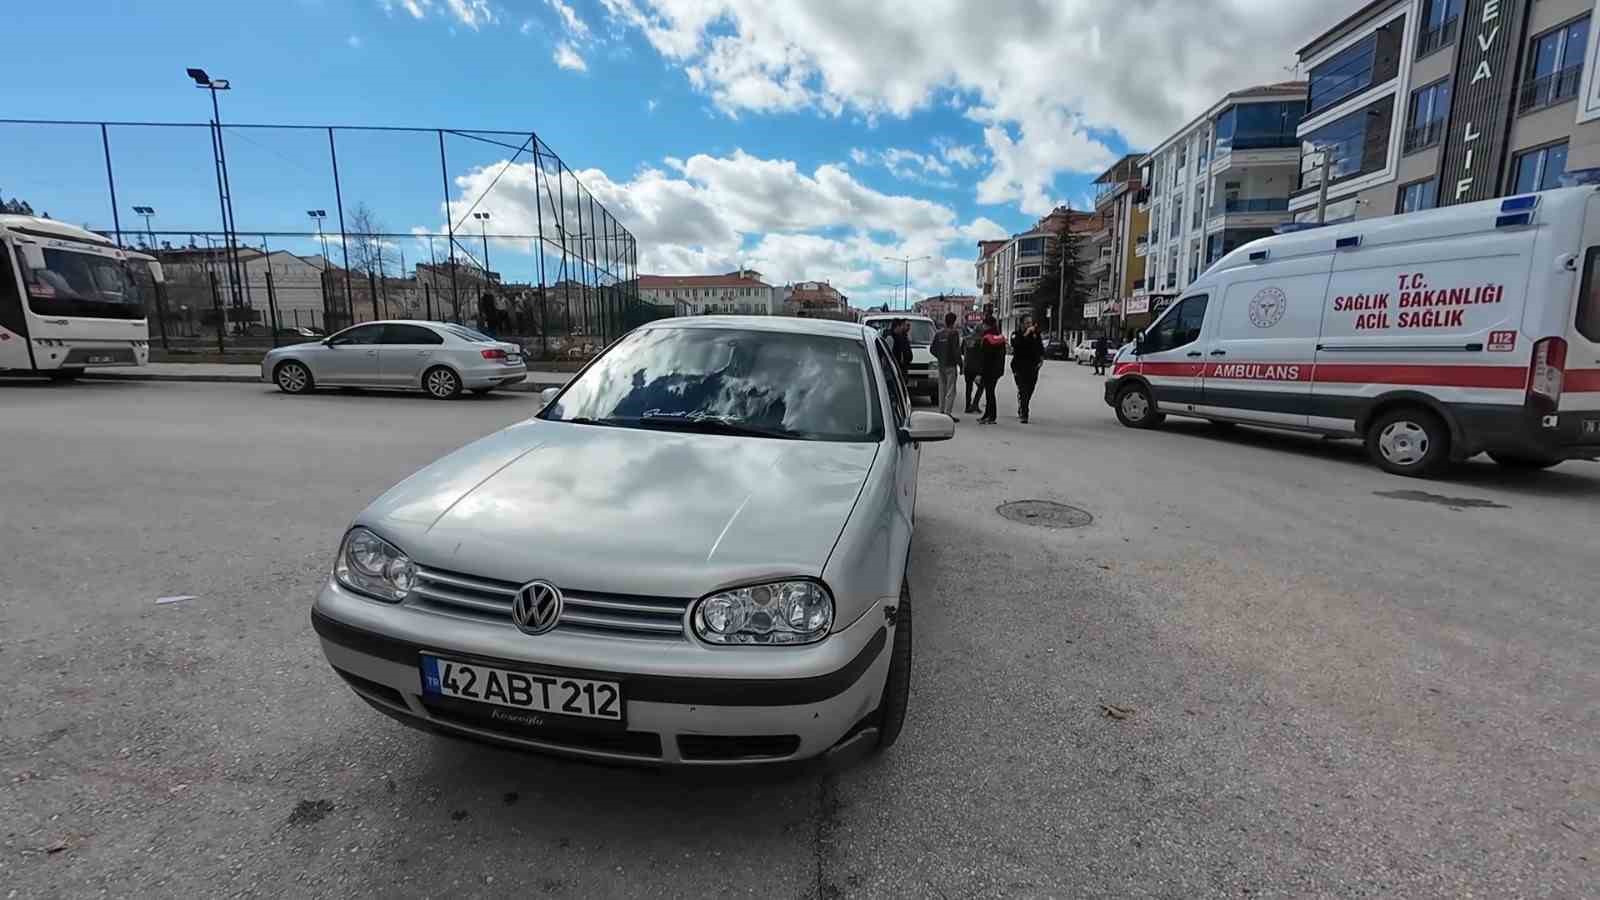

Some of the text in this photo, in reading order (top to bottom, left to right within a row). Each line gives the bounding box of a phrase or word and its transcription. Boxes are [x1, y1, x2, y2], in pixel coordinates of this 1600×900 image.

[1398, 273, 1427, 290] T.C.
[1334, 283, 1503, 311] SAĞLIK BAKANLIĞI
[1355, 309, 1464, 329] ACİL SAĞLIK
[1492, 332, 1512, 343] 112
[1213, 364, 1300, 380] AMBULANS
